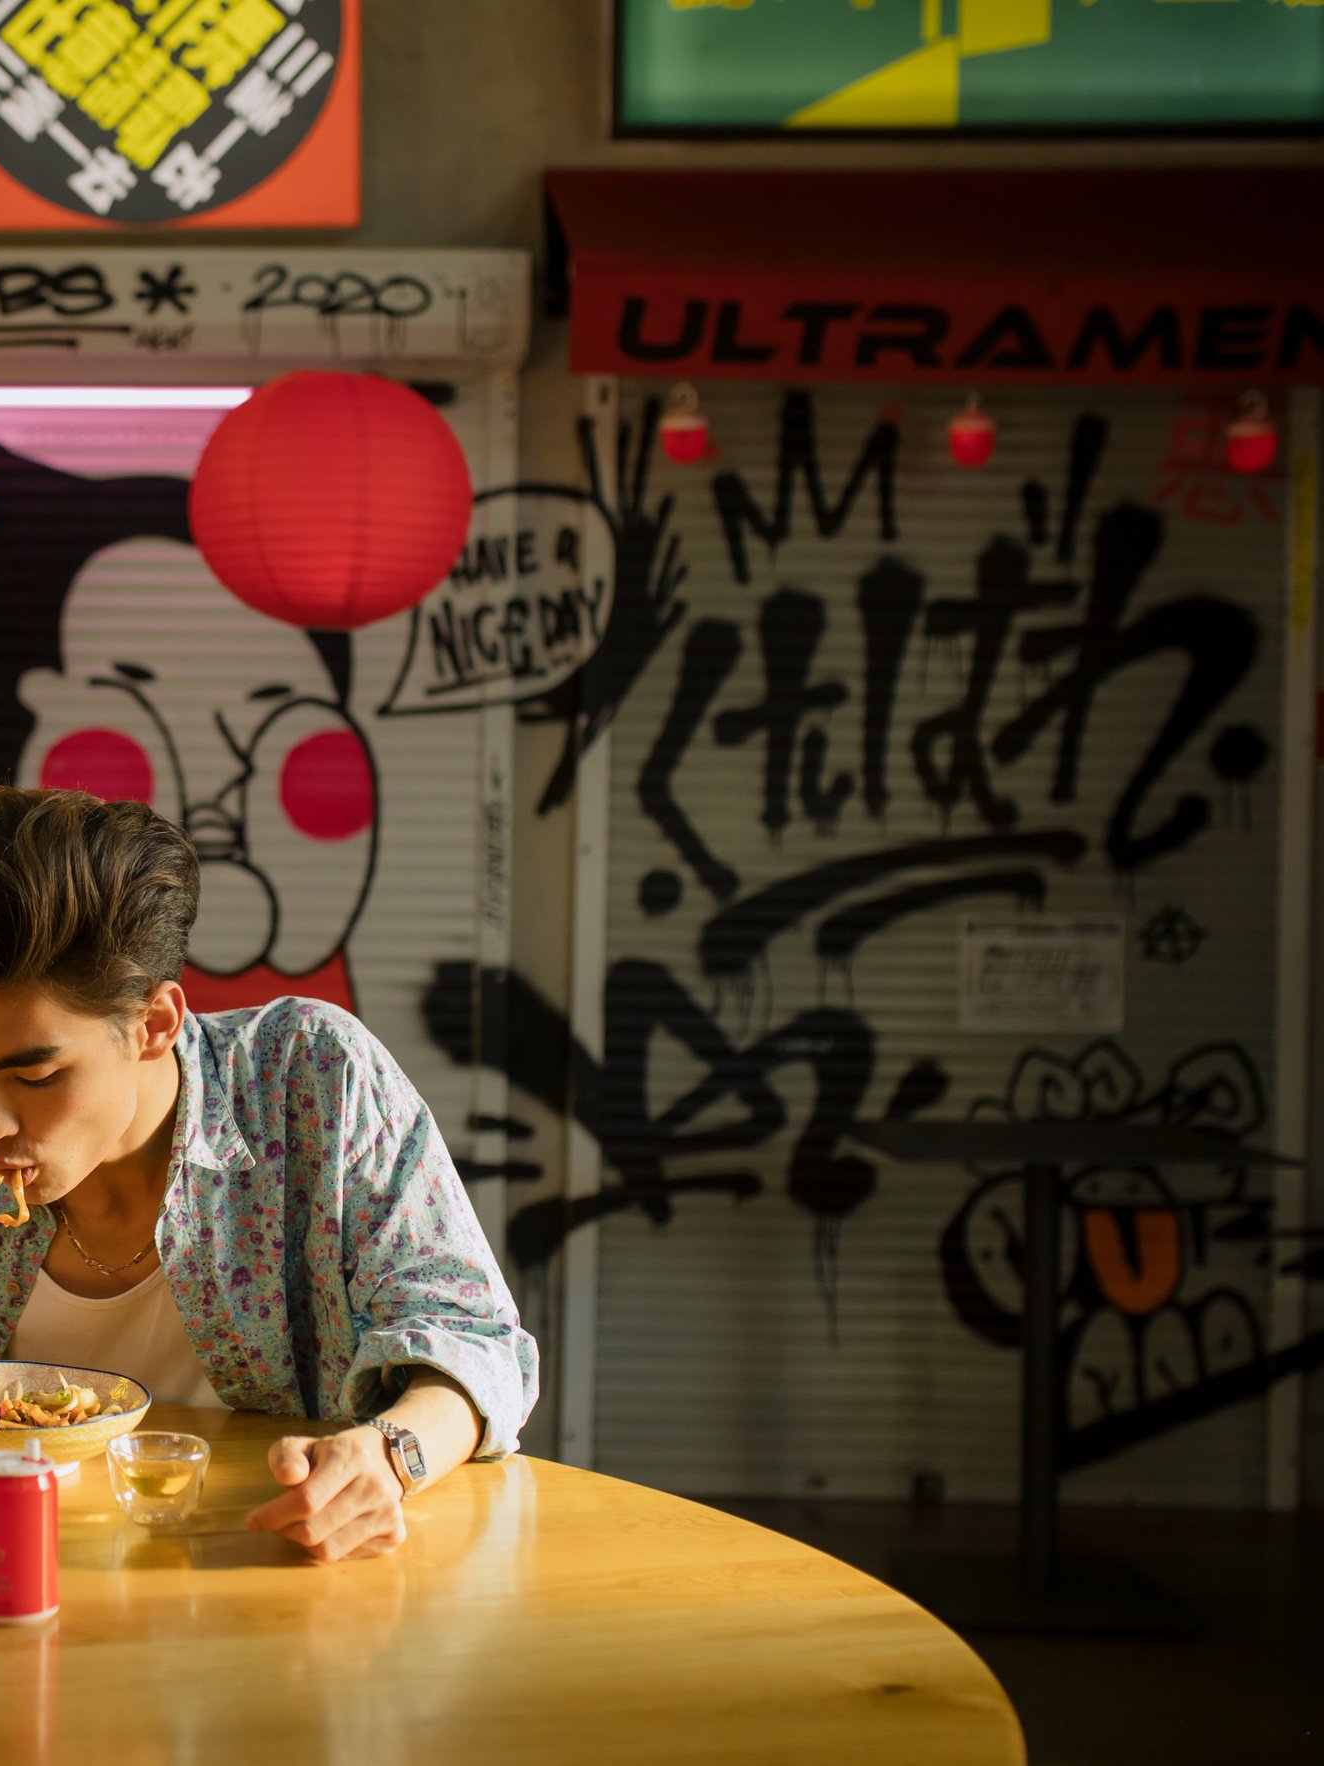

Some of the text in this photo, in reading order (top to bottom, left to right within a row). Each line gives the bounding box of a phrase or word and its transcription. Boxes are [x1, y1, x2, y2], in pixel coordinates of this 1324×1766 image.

[243, 265, 431, 317] 2020
[429, 579, 604, 684] NICE DAY
